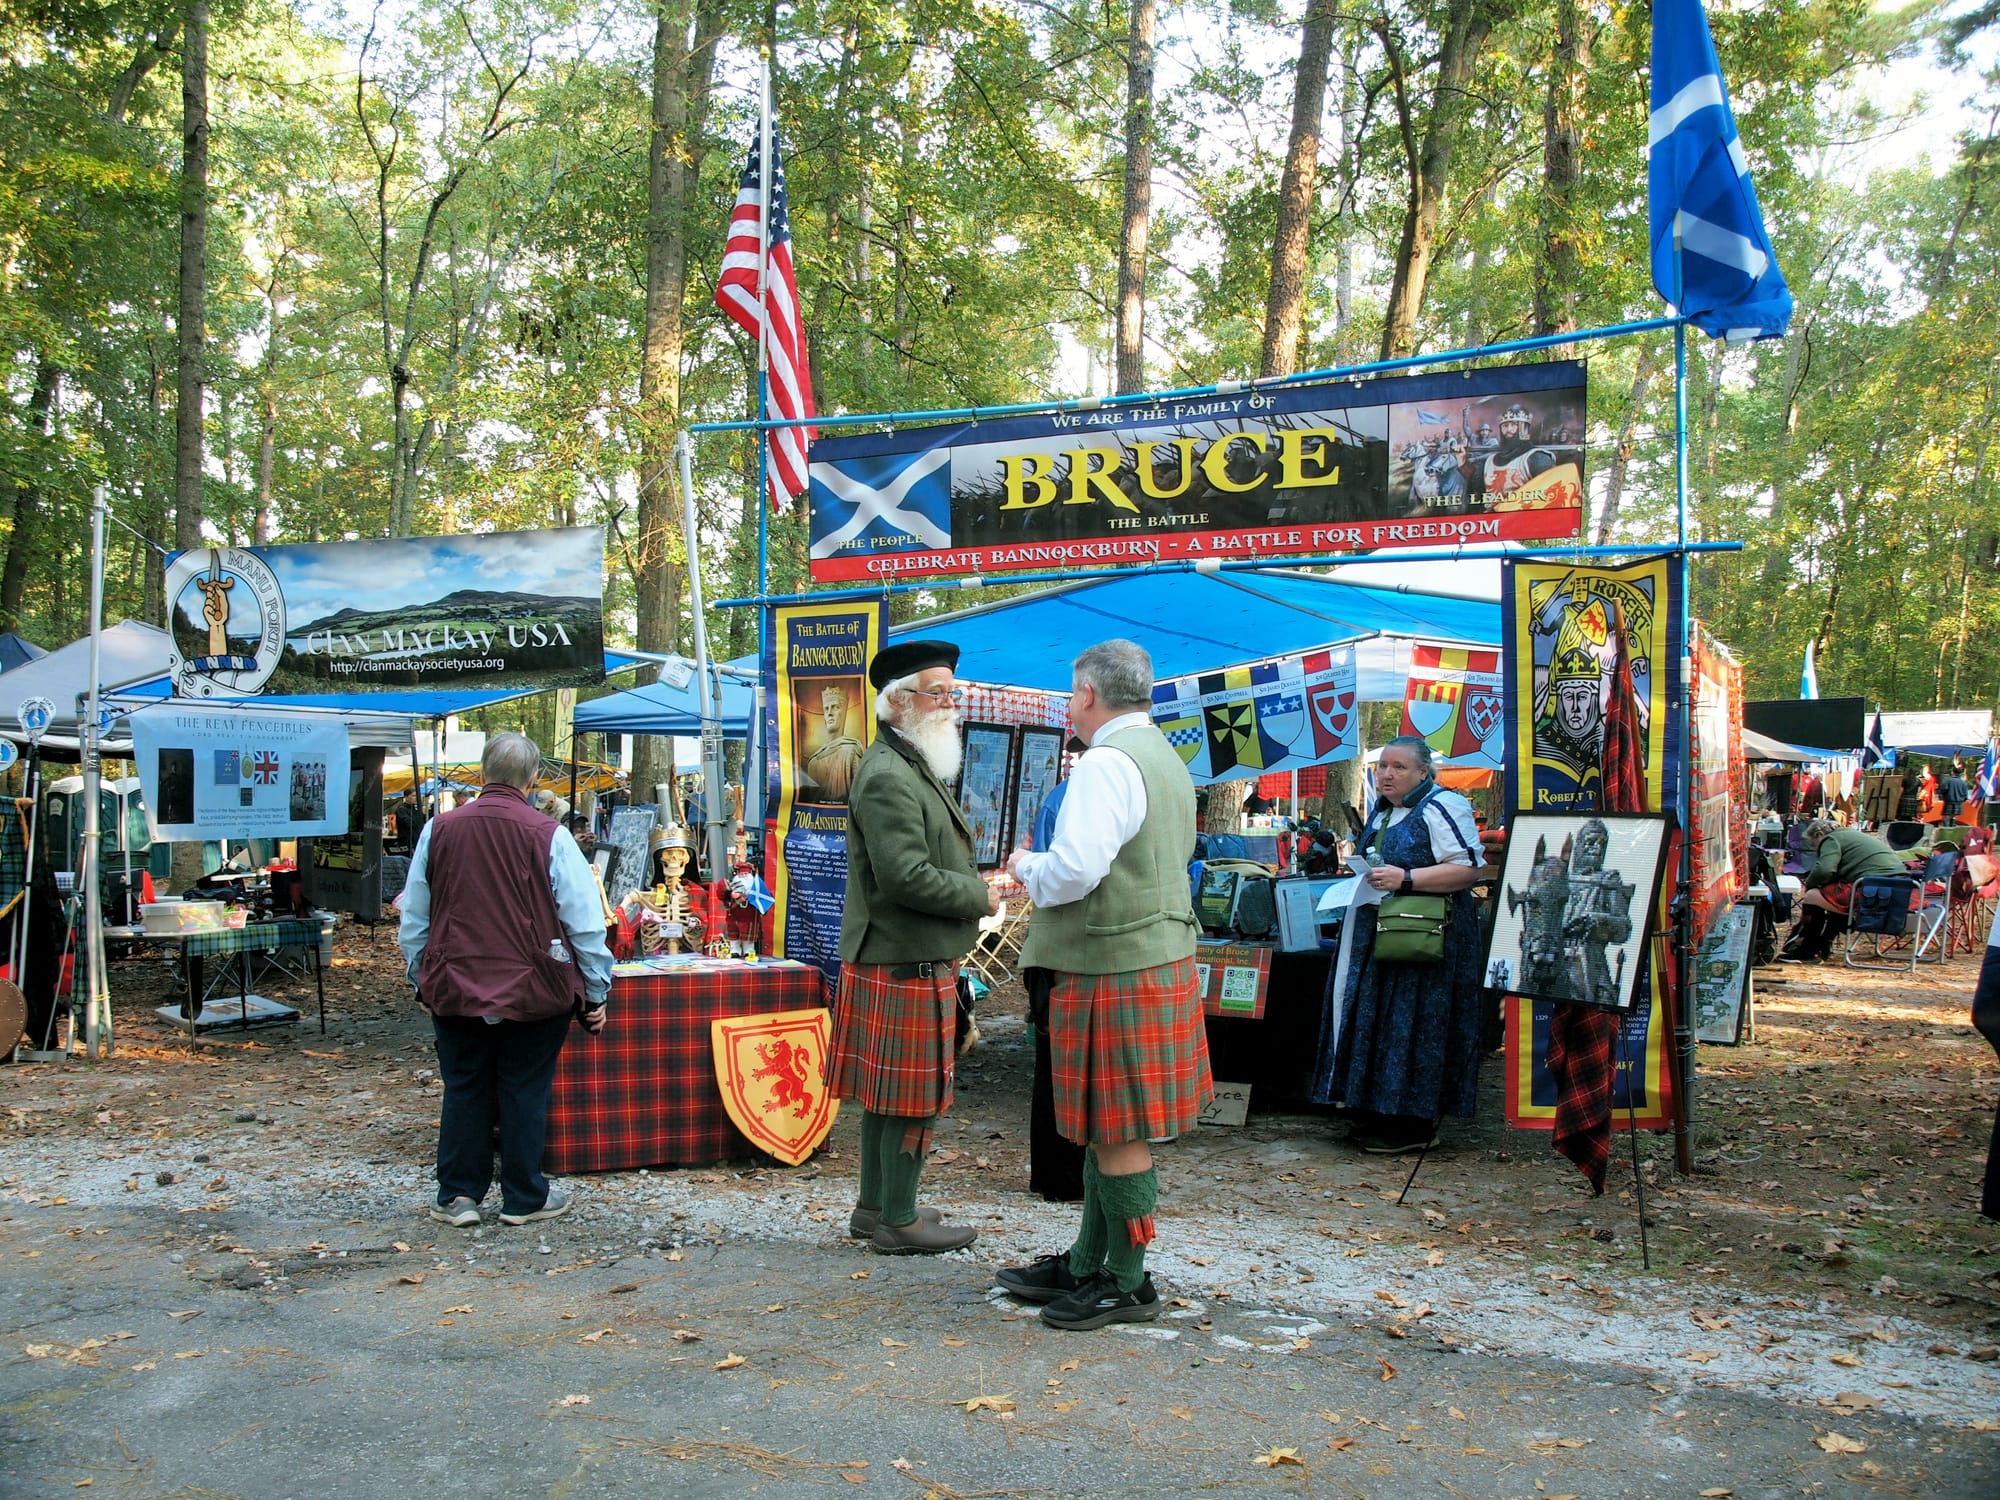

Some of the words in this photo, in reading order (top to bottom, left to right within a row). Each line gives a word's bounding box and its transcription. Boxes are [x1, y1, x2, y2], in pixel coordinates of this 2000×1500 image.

[1052, 416, 1081, 429] WE
[1086, 412, 1124, 425] ARE
[1130, 408, 1167, 421] THE
[1173, 399, 1242, 419] FAMILY
[1248, 395, 1276, 410] OF
[996, 427, 1341, 514] BRUCE
[1425, 496, 1462, 508] THE
[1470, 489, 1545, 505] LEADER
[1108, 518, 1142, 530] THE
[1148, 512, 1210, 527] BATTLE
[839, 537, 865, 550] THE
[870, 533, 924, 548] PEOPLE
[867, 551, 983, 574] CELEBRATE
[991, 540, 1160, 566] BANNOCKBURN
[1186, 537, 1204, 552] A
[1212, 531, 1302, 551] BATTLE
[1311, 528, 1366, 548] FOR
[1373, 520, 1500, 544] FREEDOM
[227, 551, 272, 594] MANU
[265, 597, 281, 657] FORTI
[1593, 578, 1650, 630] ROBERT
[508, 623, 573, 649] USA
[796, 624, 814, 637] THE
[816, 623, 845, 636] BATTLE
[847, 621, 860, 636] OF
[792, 641, 865, 669] BANNOCKBURN
[330, 658, 505, 675] http://clanmackaysocietyusa.org
[175, 717, 200, 729] THE
[206, 718, 237, 730] REAY
[815, 812, 848, 831] ANNIVER
